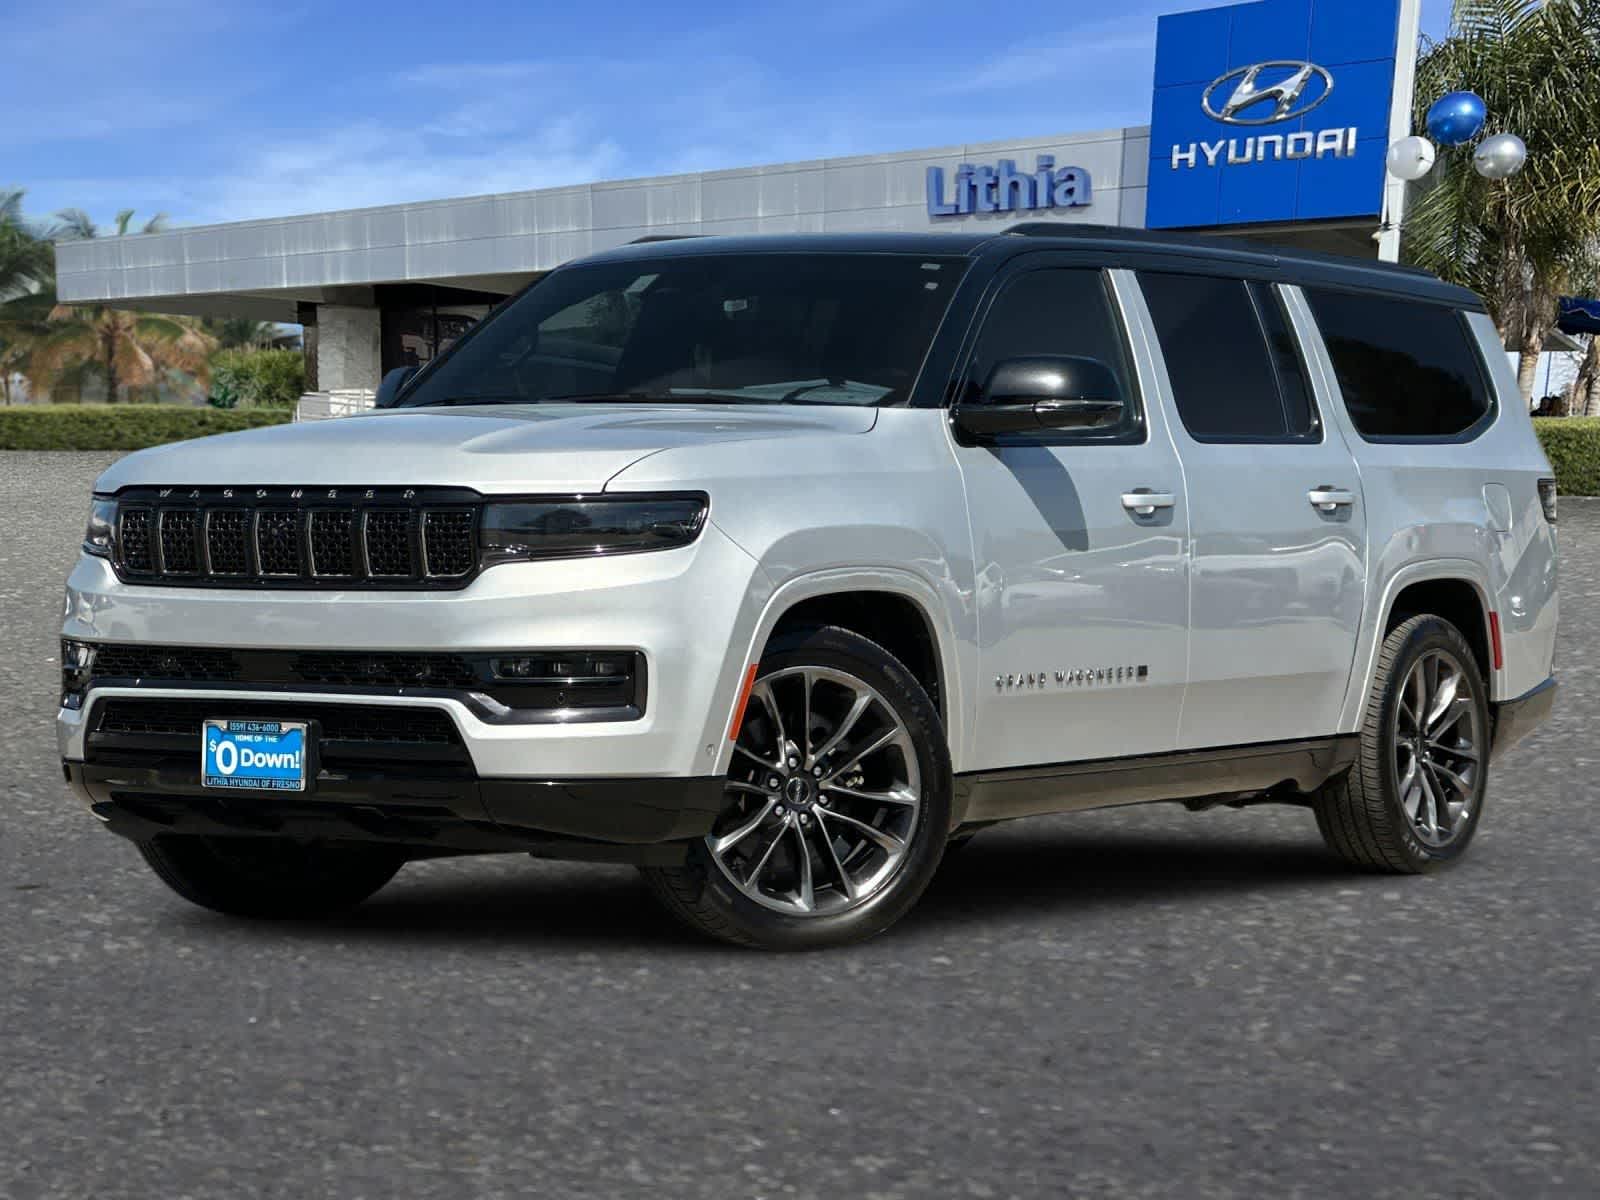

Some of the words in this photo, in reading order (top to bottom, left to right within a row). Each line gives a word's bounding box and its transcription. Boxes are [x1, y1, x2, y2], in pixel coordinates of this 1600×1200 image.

[1170, 127, 1358, 170] HYUNDAI
[926, 154, 1092, 217] Lithia
[235, 735, 252, 743] HOME
[240, 748, 300, 769] Down!
[206, 777, 228, 786] LITHIA
[229, 778, 260, 788] HYUNDAI
[261, 780, 271, 788] OF
[271, 780, 300, 789] FRESNO
